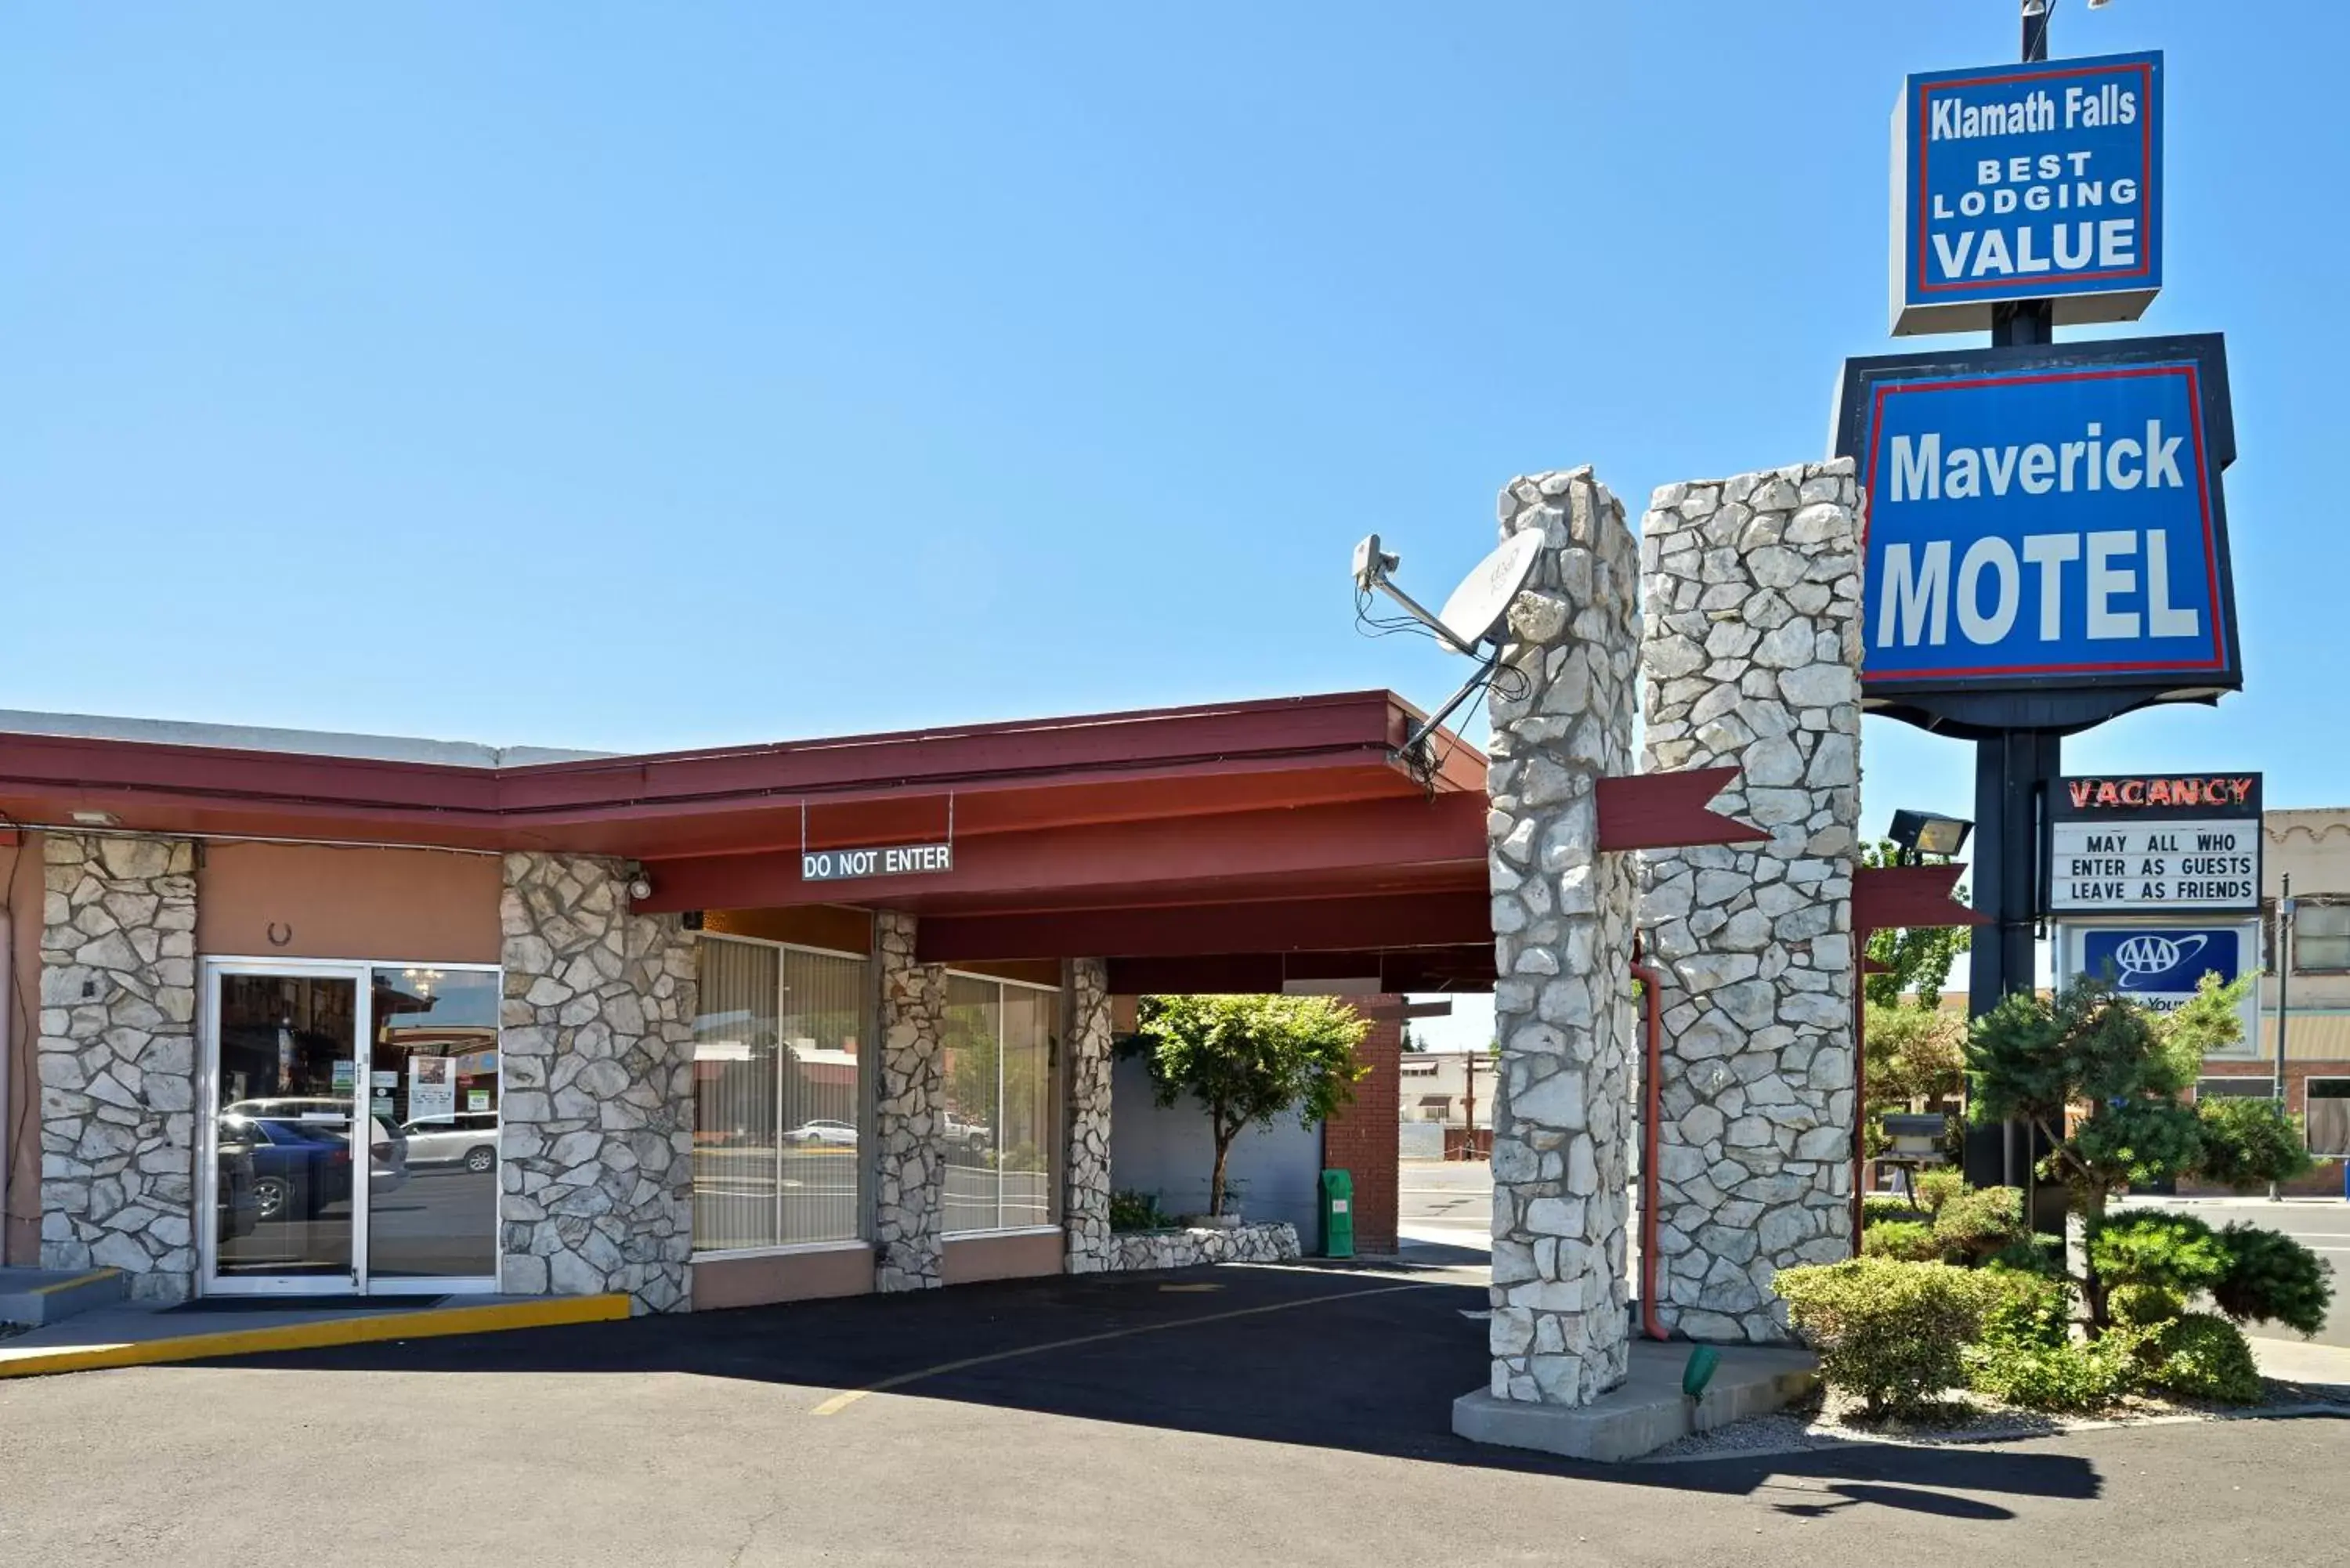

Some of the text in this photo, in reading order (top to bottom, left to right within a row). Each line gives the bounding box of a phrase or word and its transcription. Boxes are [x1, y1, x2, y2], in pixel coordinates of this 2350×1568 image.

[1931, 84, 2137, 141] Klamath Falls
[1977, 151, 2092, 185] BEST
[1933, 179, 2137, 219] LODGING
[1931, 219, 2135, 279] VALUE
[1889, 419, 2184, 502] Maverick
[1877, 529, 2200, 648] MOTEL
[2069, 777, 2253, 807] VACANCY
[2087, 834, 2236, 853] MAY ALL WHO
[804, 846, 950, 878] DO NOT ENTER
[2072, 858, 2251, 876] ENTER AS GUESTS
[2072, 881, 2252, 900] LEAVE AS FRIENDS
[2124, 939, 2172, 971] AAA
